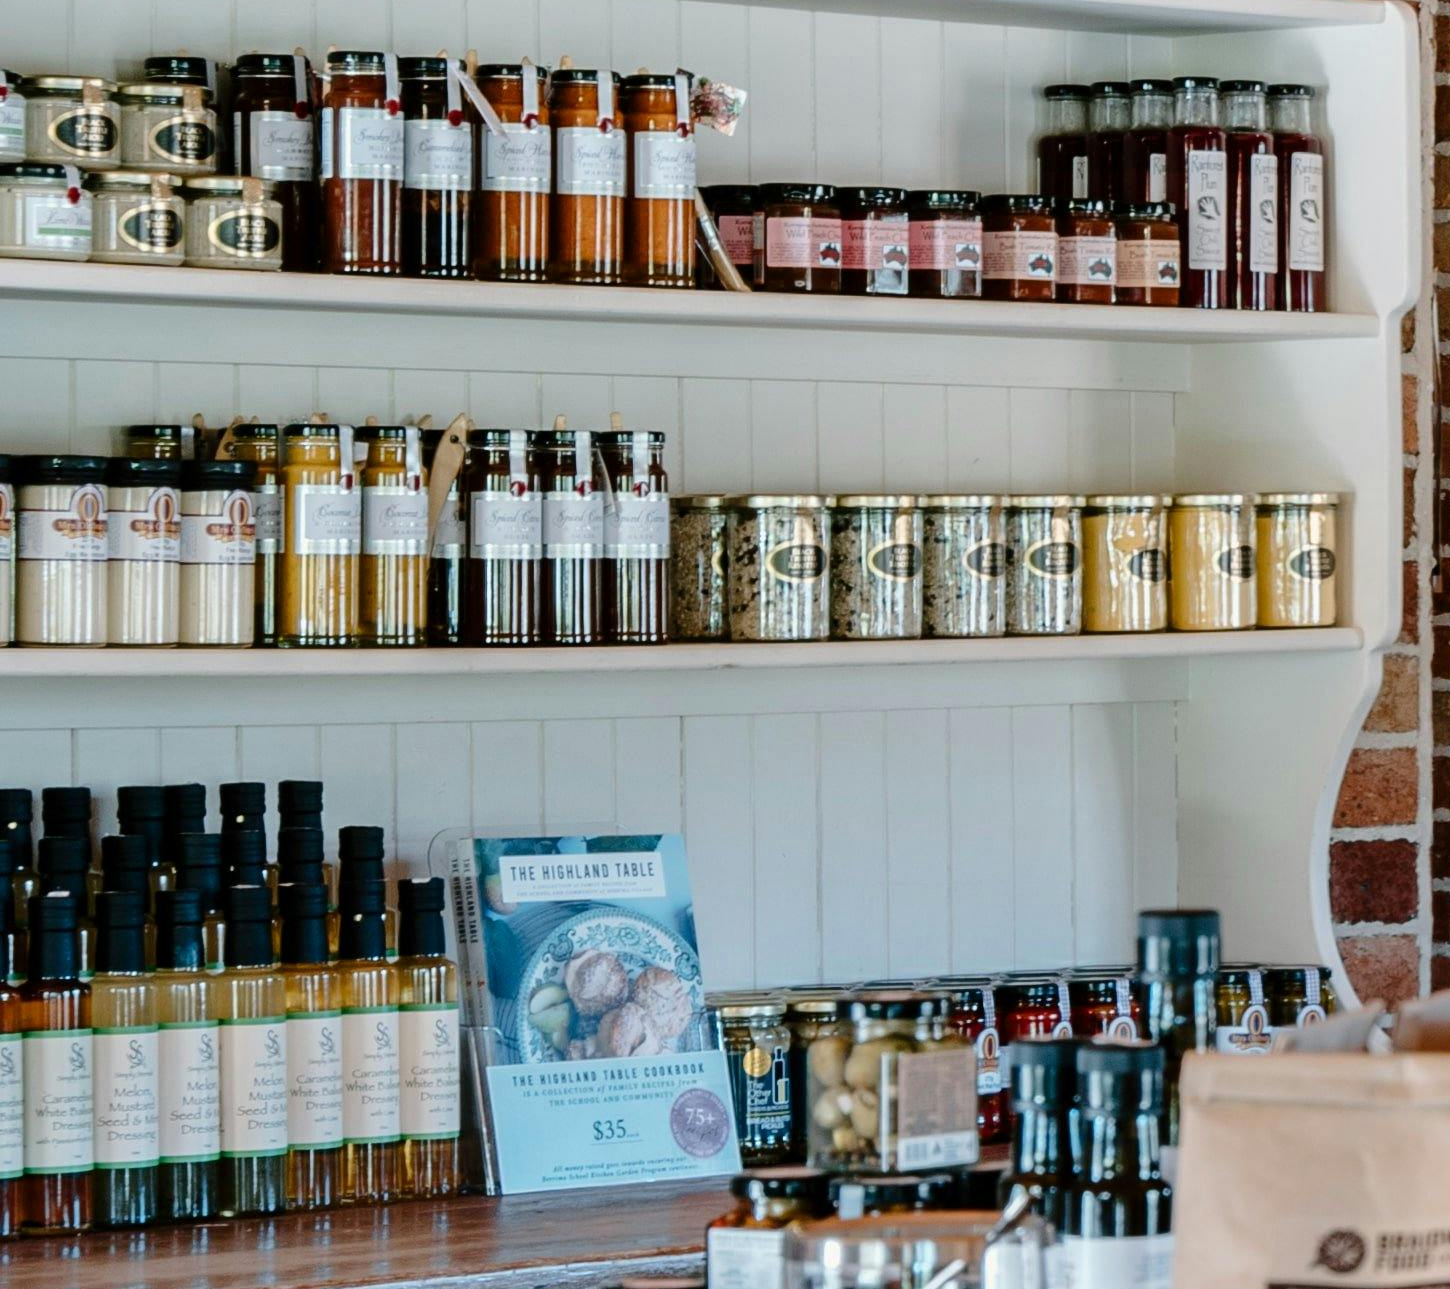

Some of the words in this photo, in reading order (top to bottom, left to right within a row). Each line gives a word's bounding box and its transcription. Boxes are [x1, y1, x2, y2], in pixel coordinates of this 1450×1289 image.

[510, 866, 535, 881] THE
[542, 863, 609, 880] HIGHLAND
[615, 862, 655, 878] TABLE
[465, 877, 477, 917] HIGHLAND
[512, 1075, 535, 1087] THE
[540, 1071, 597, 1085] HIGHLAND
[603, 1068, 638, 1081] TABLE
[644, 1063, 705, 1078] COOKBOOK
[523, 1090, 530, 1098] IS
[541, 1086, 594, 1098] COLLECTION
[608, 1083, 639, 1092] FAMILY
[641, 1081, 676, 1090] RECIPES
[678, 1078, 699, 1088] from
[549, 1099, 565, 1107] THE
[567, 1097, 600, 1106] SCHOOL
[603, 1096, 620, 1104] AND
[623, 1092, 674, 1103] COMMUNITY
[685, 1108, 715, 1125] 75+
[593, 1119, 627, 1141] $35
[568, 1173, 587, 1181] School
